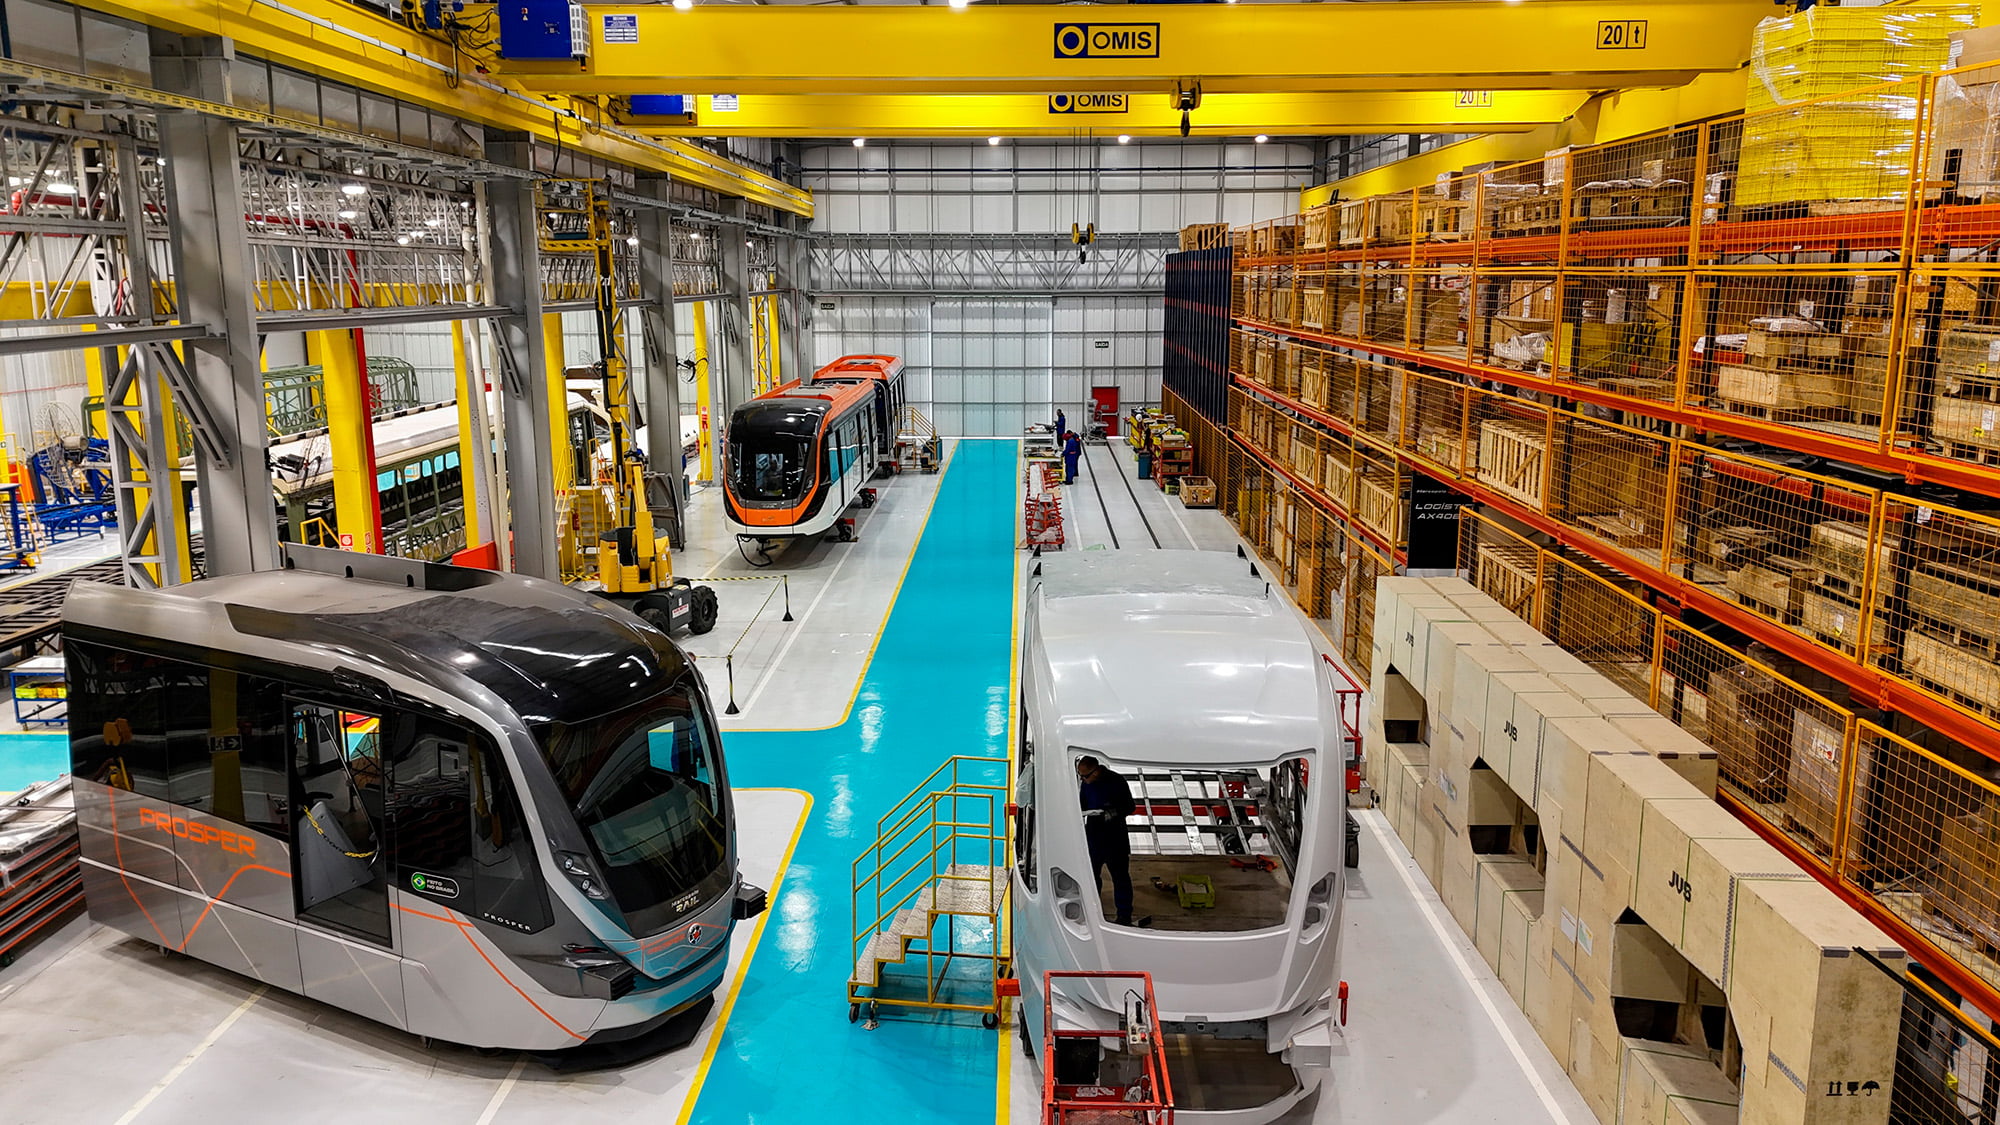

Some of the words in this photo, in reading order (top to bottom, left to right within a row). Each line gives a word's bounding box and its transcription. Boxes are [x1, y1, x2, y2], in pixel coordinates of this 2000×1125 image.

[1093, 31, 1152, 50] OMIS
[1603, 25, 1622, 45] 20
[1634, 26, 1640, 44] t
[1078, 94, 1123, 107] OMIS
[1460, 90, 1474, 104] 20
[140, 807, 257, 859] PROSPER
[427, 879, 443, 887] FEITO
[436, 885, 456, 894] BRASIL
[484, 912, 531, 931] PROSPER
